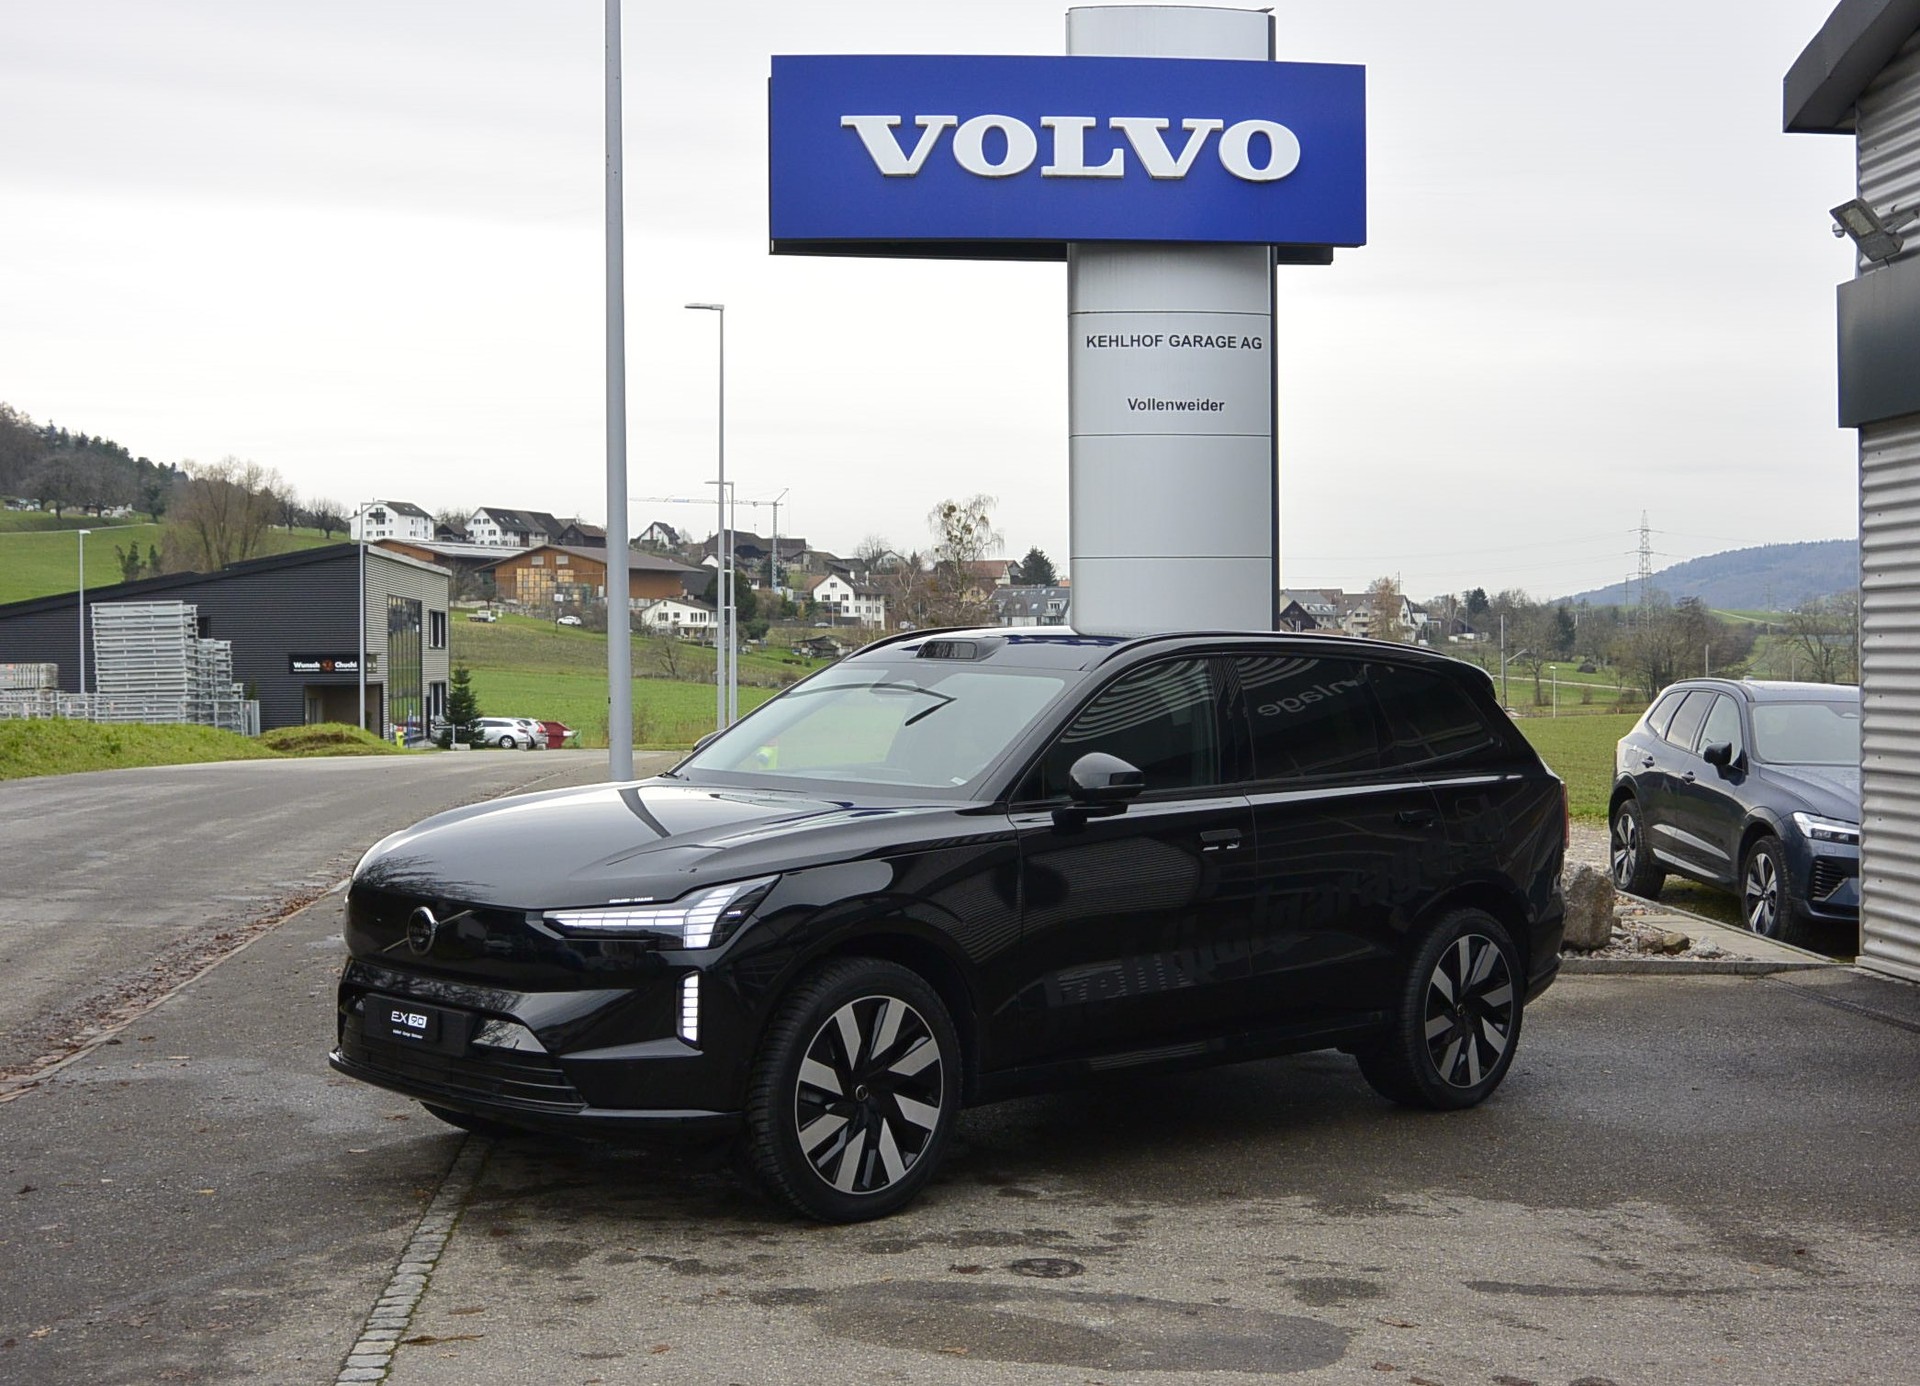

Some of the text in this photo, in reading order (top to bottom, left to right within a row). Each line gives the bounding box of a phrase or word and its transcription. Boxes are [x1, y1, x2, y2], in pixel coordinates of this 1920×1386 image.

[840, 114, 1301, 182] VOLVO
[1086, 334, 1263, 350] KEHLHOF GARAGE AG
[1127, 397, 1225, 412] Vollenweider
[391, 1010, 427, 1029] EX90
